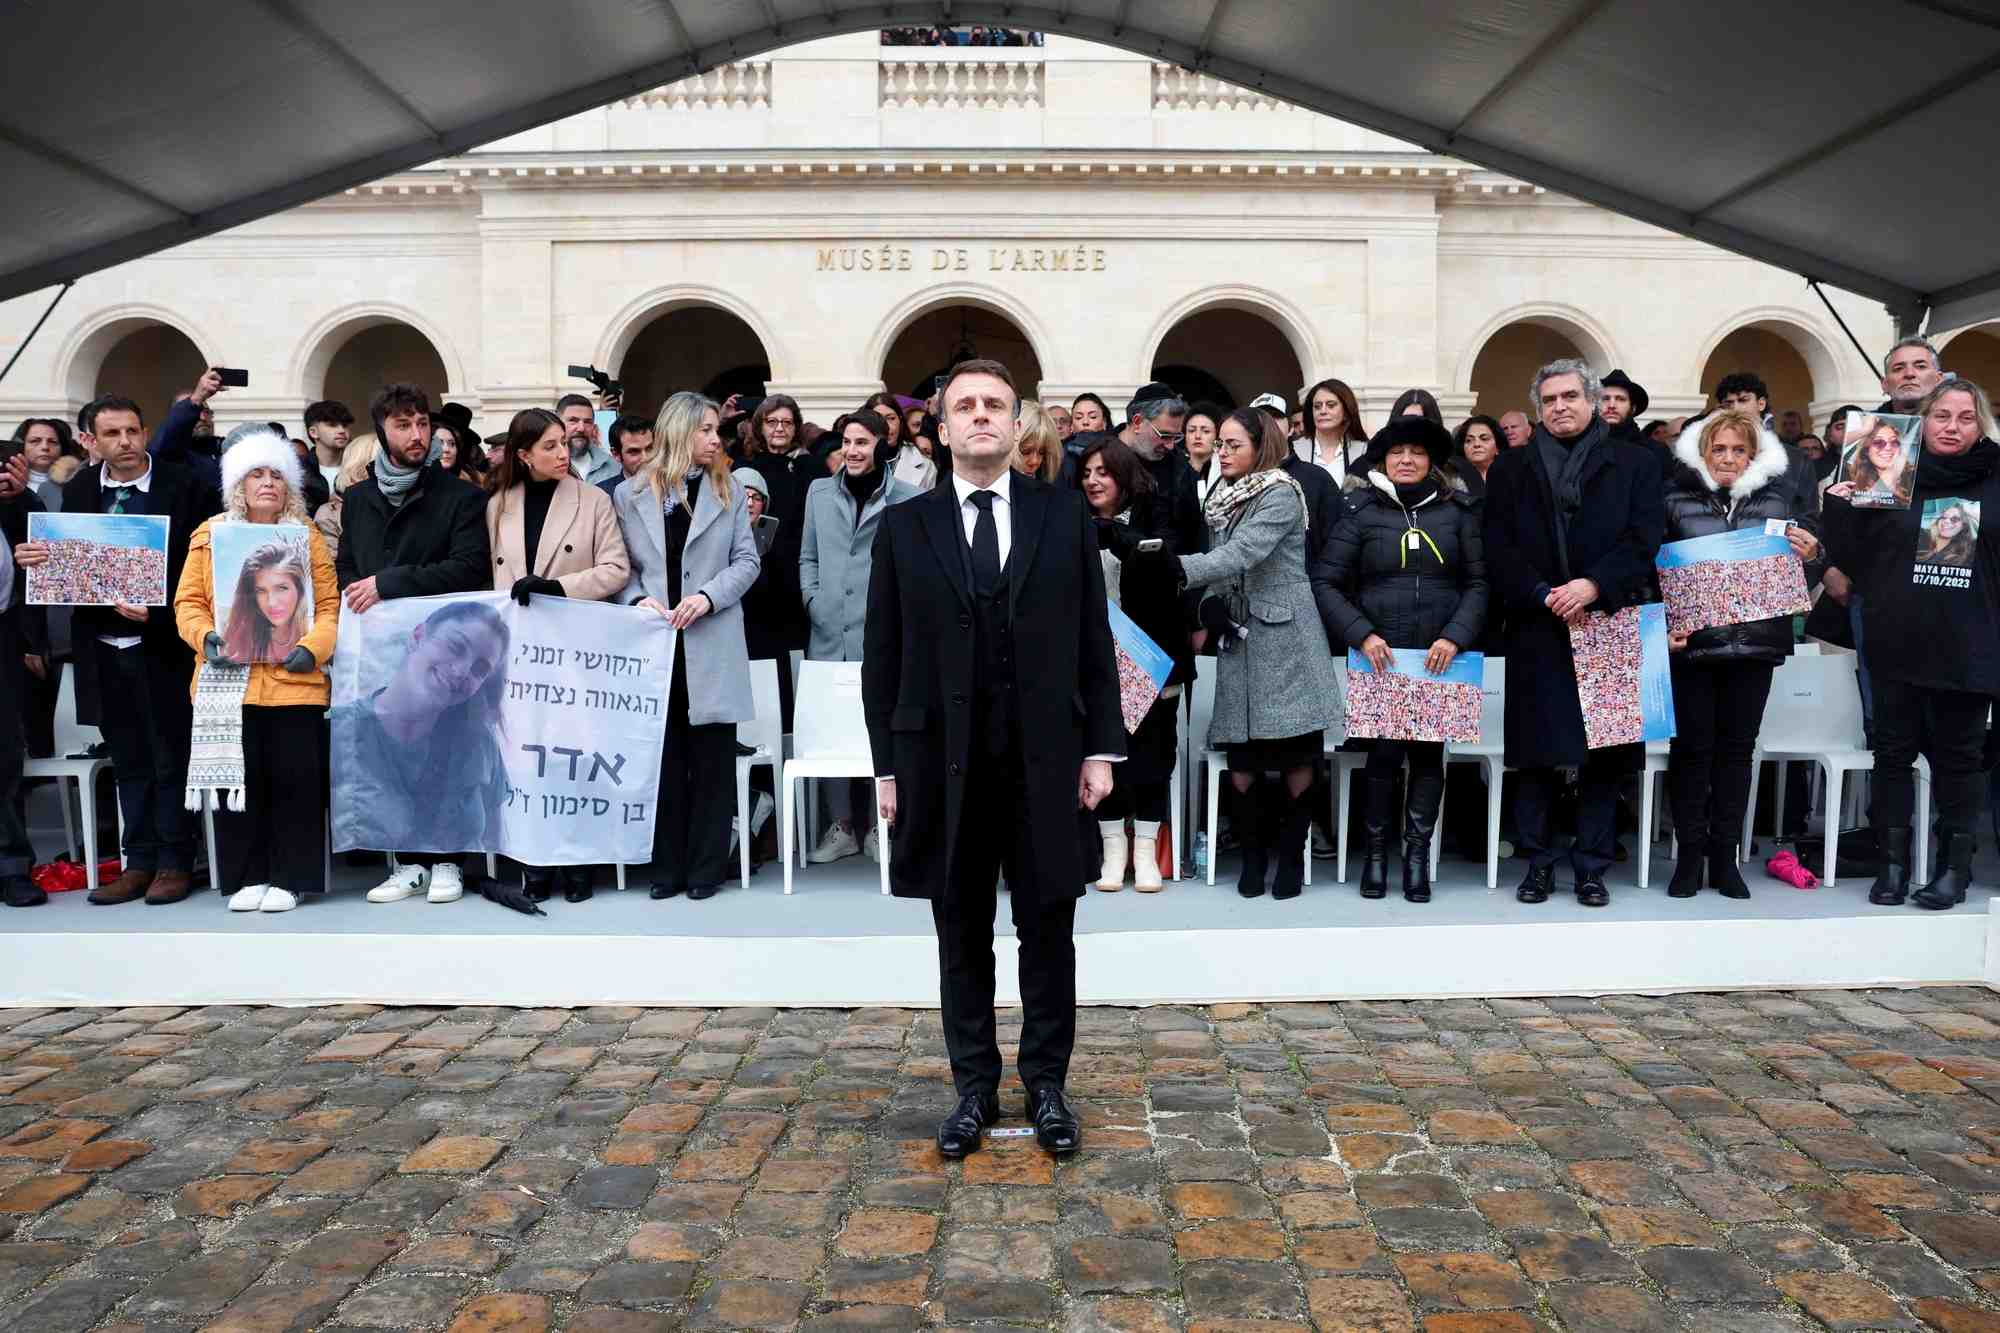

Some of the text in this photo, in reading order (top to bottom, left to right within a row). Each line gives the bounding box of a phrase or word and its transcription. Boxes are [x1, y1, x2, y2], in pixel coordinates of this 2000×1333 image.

[816, 244, 1108, 272] MUSÉE DE L'ARMÉE
[1912, 574, 1971, 589] 07/10/2023
[1913, 564, 1973, 578] MAYA BITTON
[514, 643, 565, 665] זמני,
[585, 688, 659, 716] הגאווה
[521, 743, 627, 787] אדר
[542, 794, 610, 819] סימון
[622, 801, 646, 825] בן
